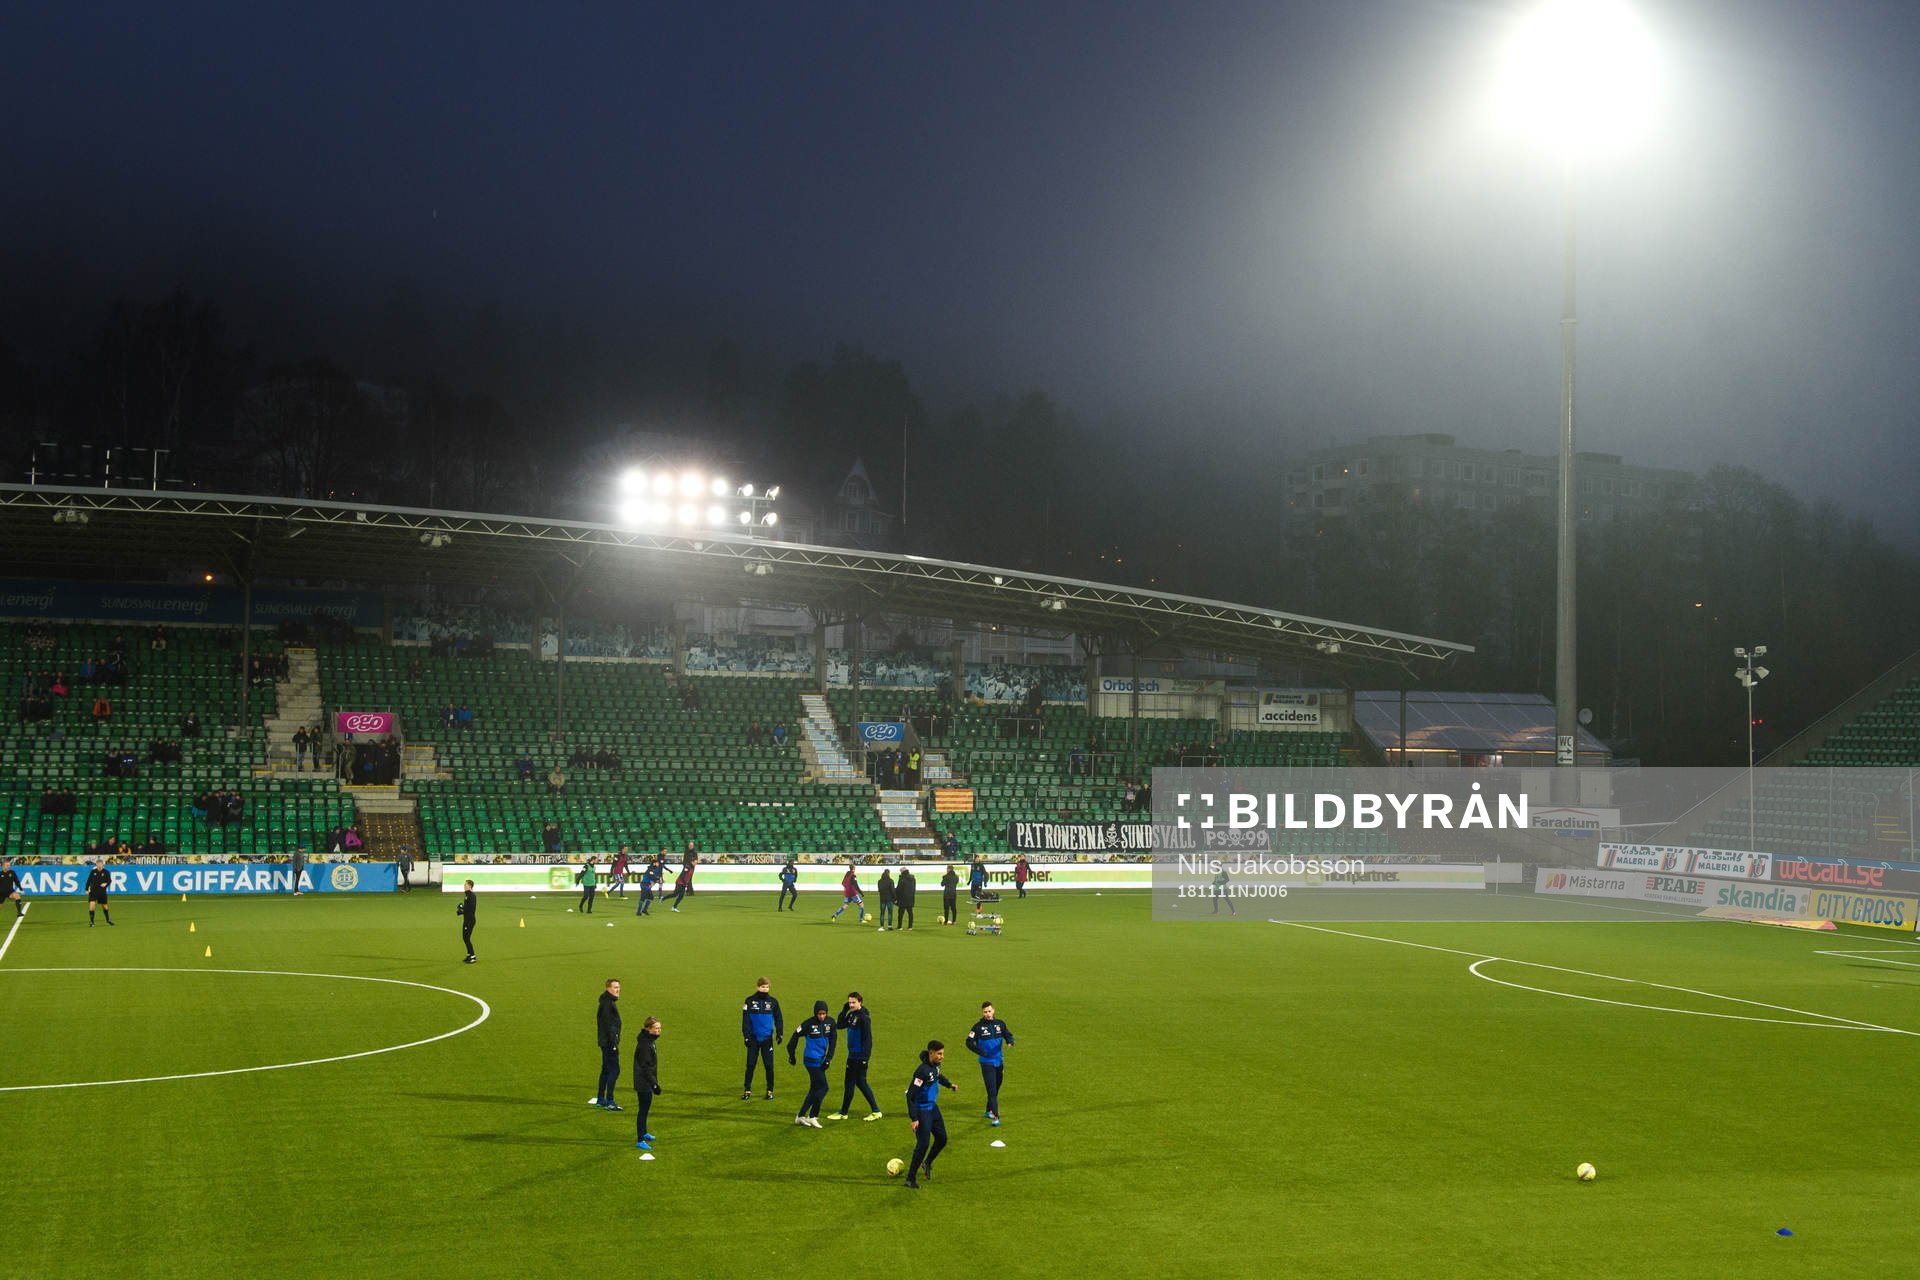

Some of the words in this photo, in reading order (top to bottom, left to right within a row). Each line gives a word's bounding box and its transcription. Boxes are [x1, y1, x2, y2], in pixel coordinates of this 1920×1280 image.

[1103, 680, 1160, 692] Orboech
[346, 714, 384, 732] ego
[865, 724, 898, 740] ego
[1559, 736, 1573, 747] WC
[1532, 816, 1600, 829] Faradium
[1016, 823, 1107, 850] PATRONERNA
[1121, 825, 1196, 850] SUNDSVALL
[1648, 858, 1659, 866] AB
[1733, 865, 1745, 873] AB
[136, 871, 164, 892] VI
[1569, 875, 1625, 890] Mästarna
[1652, 876, 1698, 894] PEAB
[1717, 885, 1797, 912] skandia
[1816, 892, 1851, 919] CITY
[1851, 896, 1905, 927] GROSS
